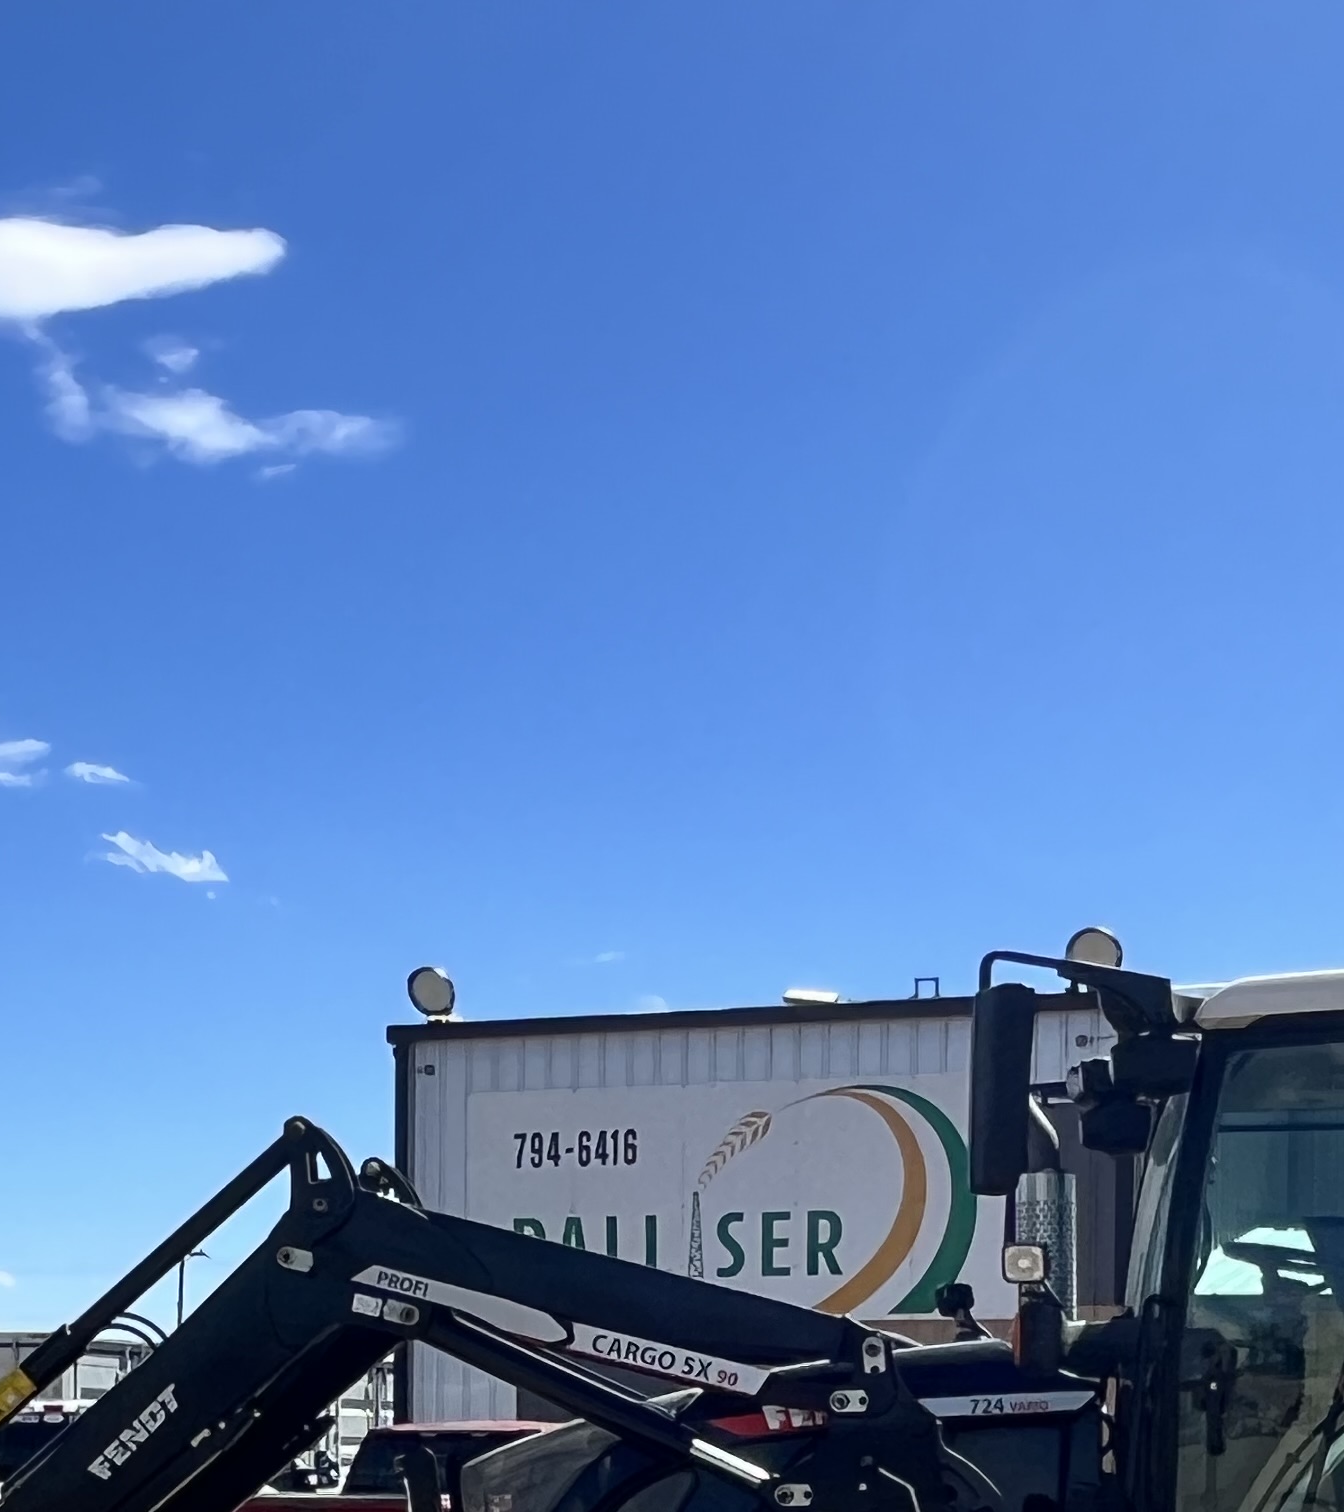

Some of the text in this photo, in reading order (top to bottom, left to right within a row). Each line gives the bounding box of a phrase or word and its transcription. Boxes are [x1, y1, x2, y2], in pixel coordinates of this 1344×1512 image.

[513, 1128, 638, 1169] 794-6416
[376, 1270, 429, 1298] PROFI
[592, 1334, 738, 1387] CARGO 5X 90
[969, 1398, 1005, 1414] 724
[87, 1383, 179, 1480] FENDT
